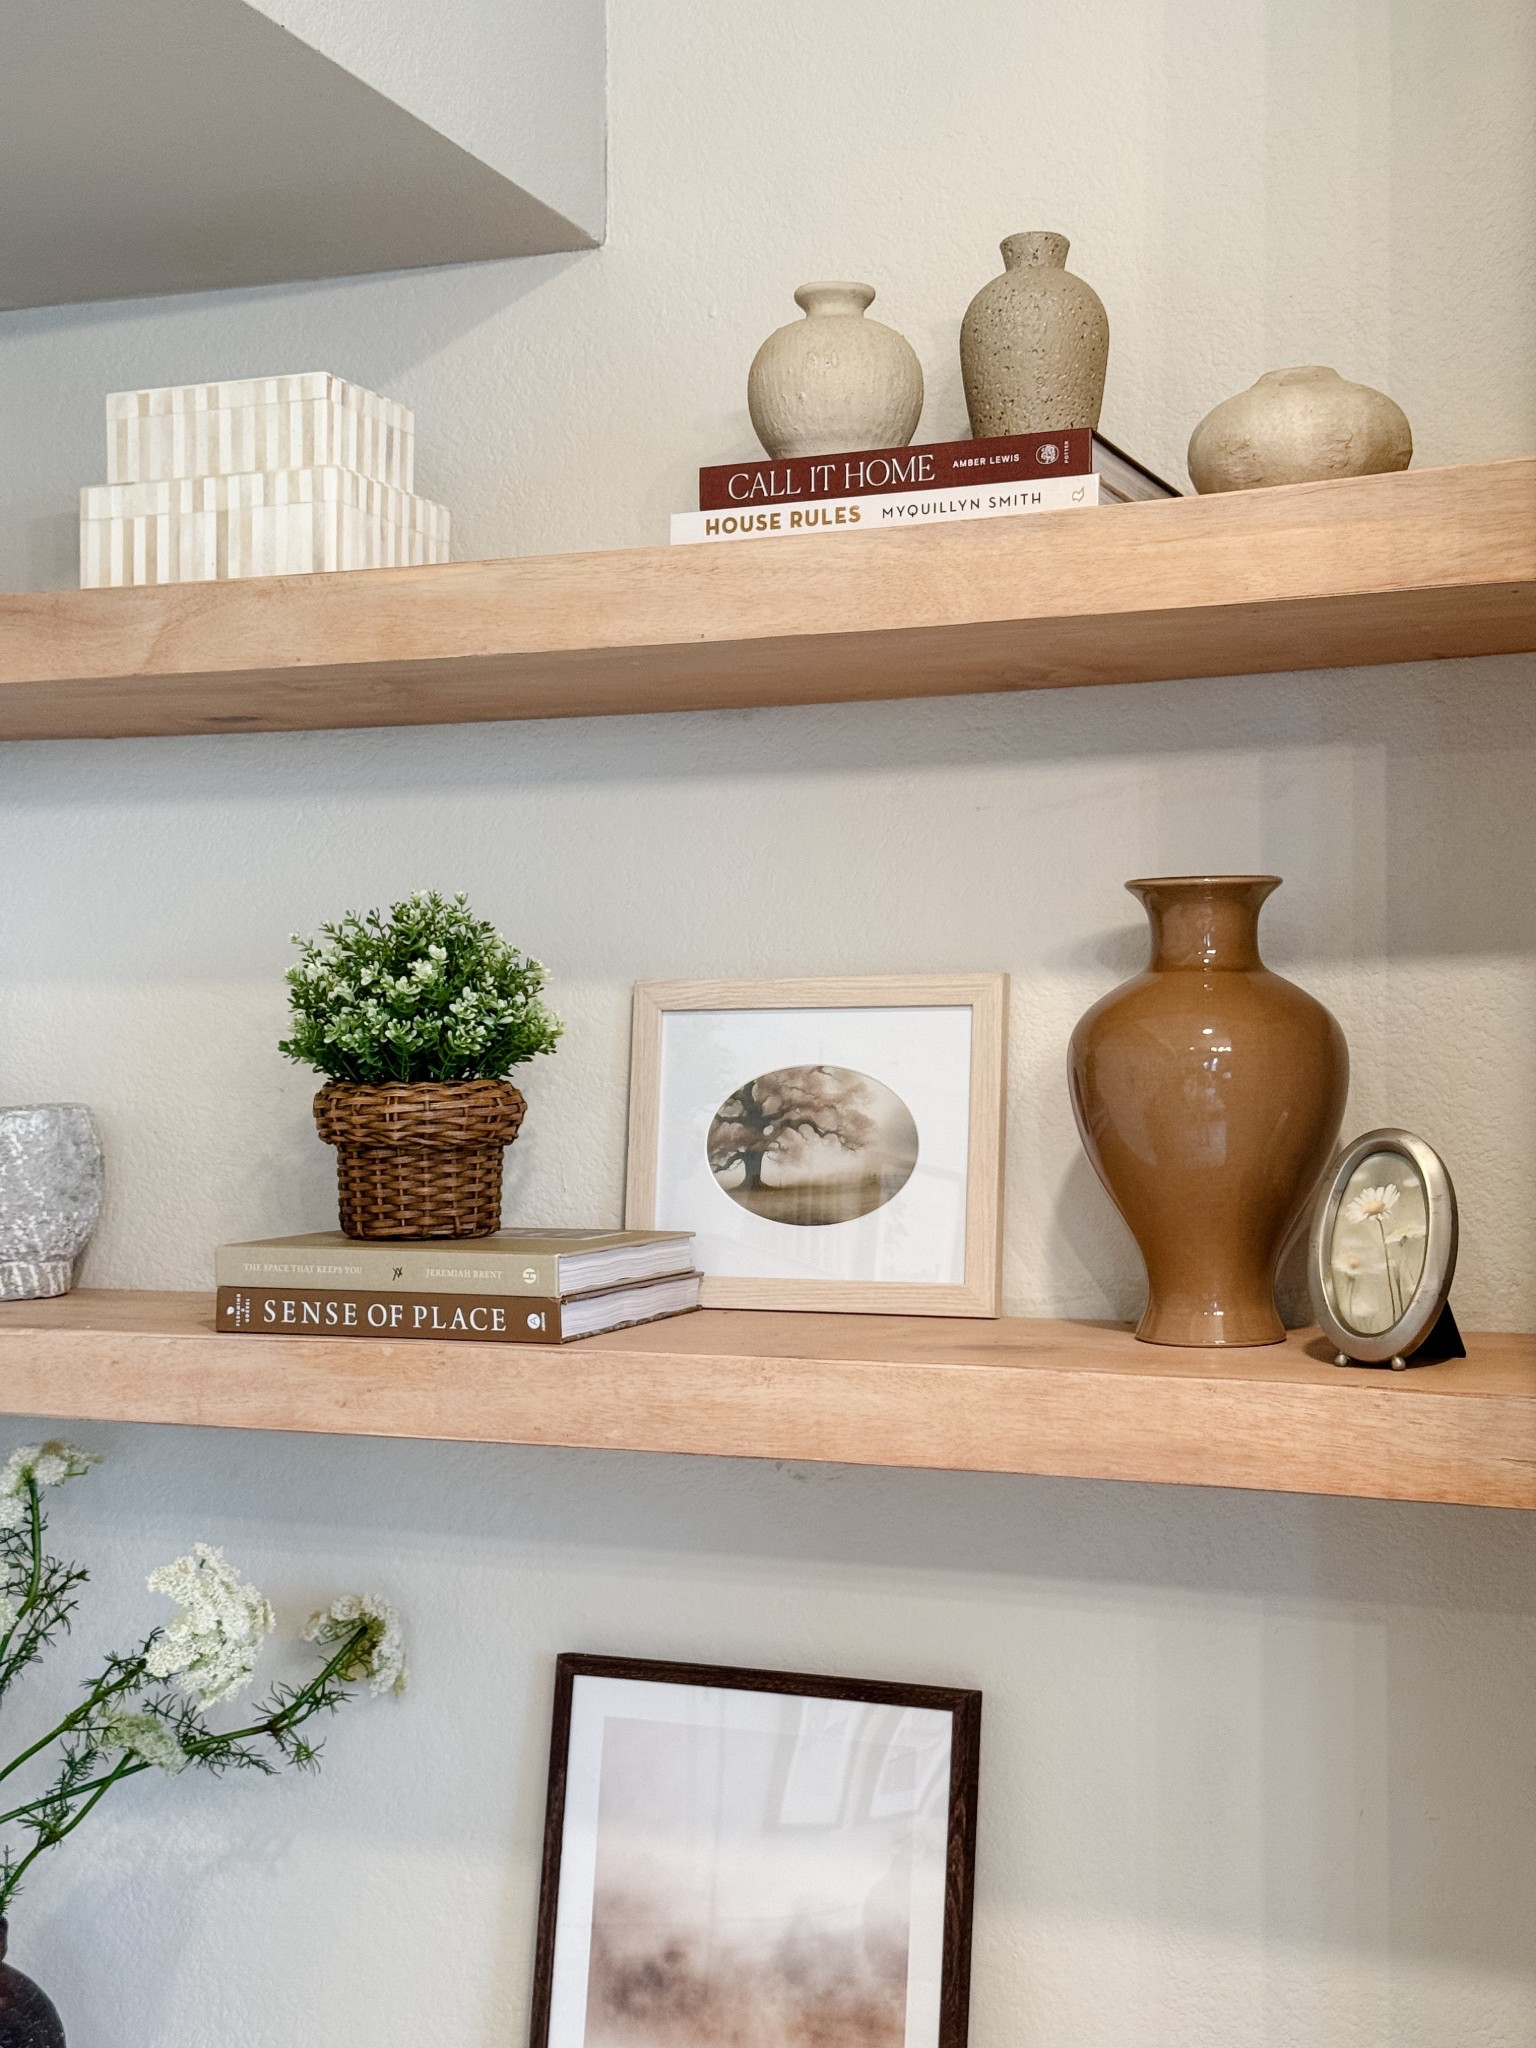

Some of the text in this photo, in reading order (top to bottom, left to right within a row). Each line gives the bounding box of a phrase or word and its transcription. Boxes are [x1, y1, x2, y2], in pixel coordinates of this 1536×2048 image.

[952, 454, 1020, 469] AMBER LEWIS
[728, 454, 936, 500] CALL IT HOME
[882, 492, 1042, 519] MYQUILLYN SMITH
[706, 505, 861, 536] HOUSE RULES
[243, 1263, 363, 1274] THE SPACE THAT KEEPS YOU
[426, 1268, 503, 1279] JEREMIAH BRENT
[263, 1299, 507, 1332] SENSE OF PLACE
